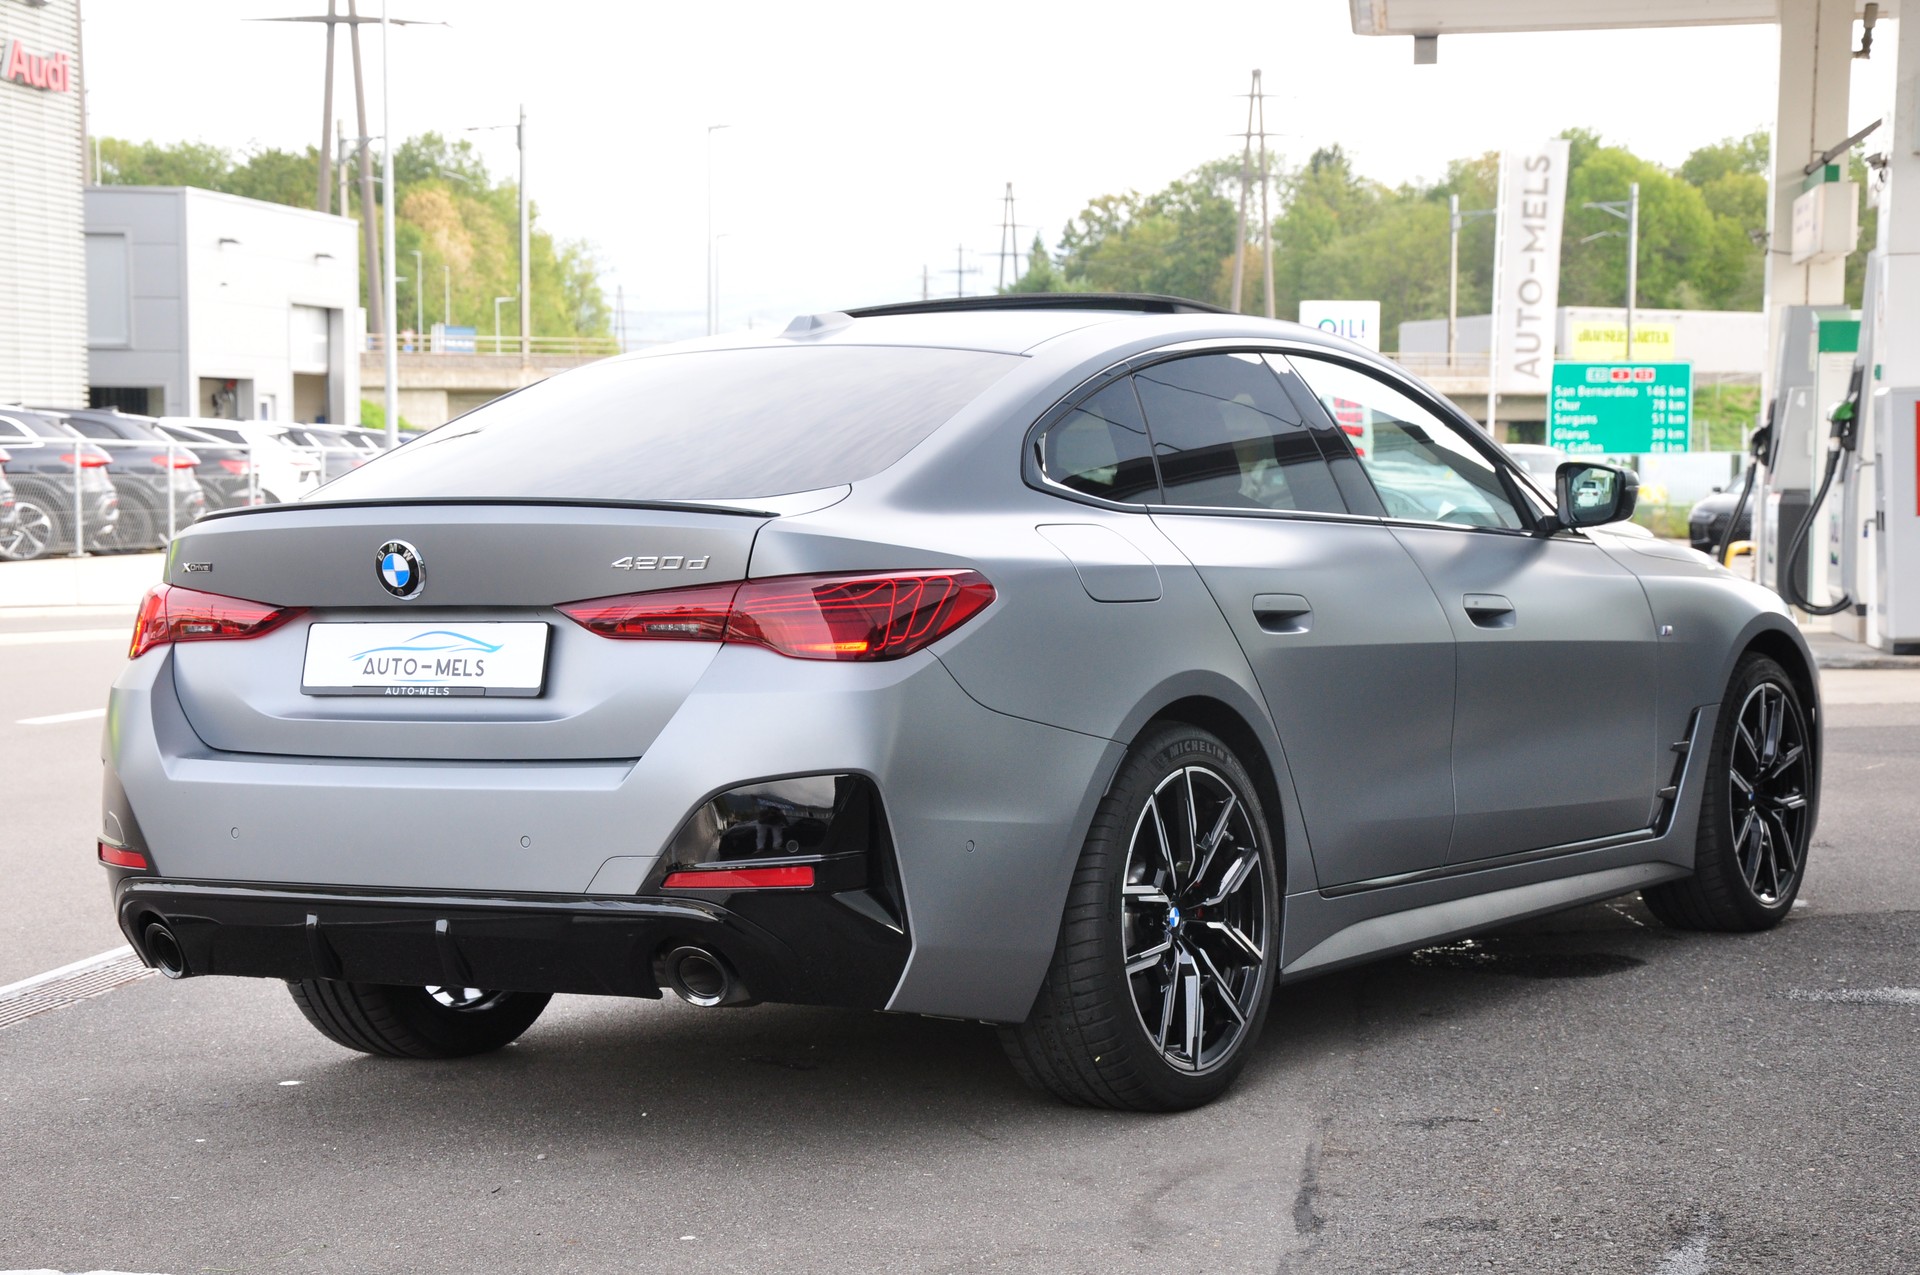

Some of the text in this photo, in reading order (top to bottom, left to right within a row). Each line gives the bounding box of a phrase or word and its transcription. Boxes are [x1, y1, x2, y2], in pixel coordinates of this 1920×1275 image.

[8, 39, 69, 92] Audi
[1514, 155, 1551, 379] AUTO-MELS
[1318, 319, 1365, 338] OIL!
[1555, 385, 1576, 397] San
[1577, 385, 1638, 397] Bernardino
[1668, 385, 1687, 397] km
[1554, 399, 1686, 411] Chur 78 km
[1797, 391, 1806, 408] 4
[1554, 413, 1686, 427] Sargans 51 km
[1553, 428, 1590, 440] Glarus
[1667, 428, 1686, 440] km
[1667, 441, 1685, 453] km
[378, 543, 413, 561] BMW
[611, 555, 710, 570] 420d
[362, 657, 485, 677] AUTO-MELS
[385, 687, 450, 696] AUTO-MELS
[1169, 740, 1225, 760] MICHELIN
